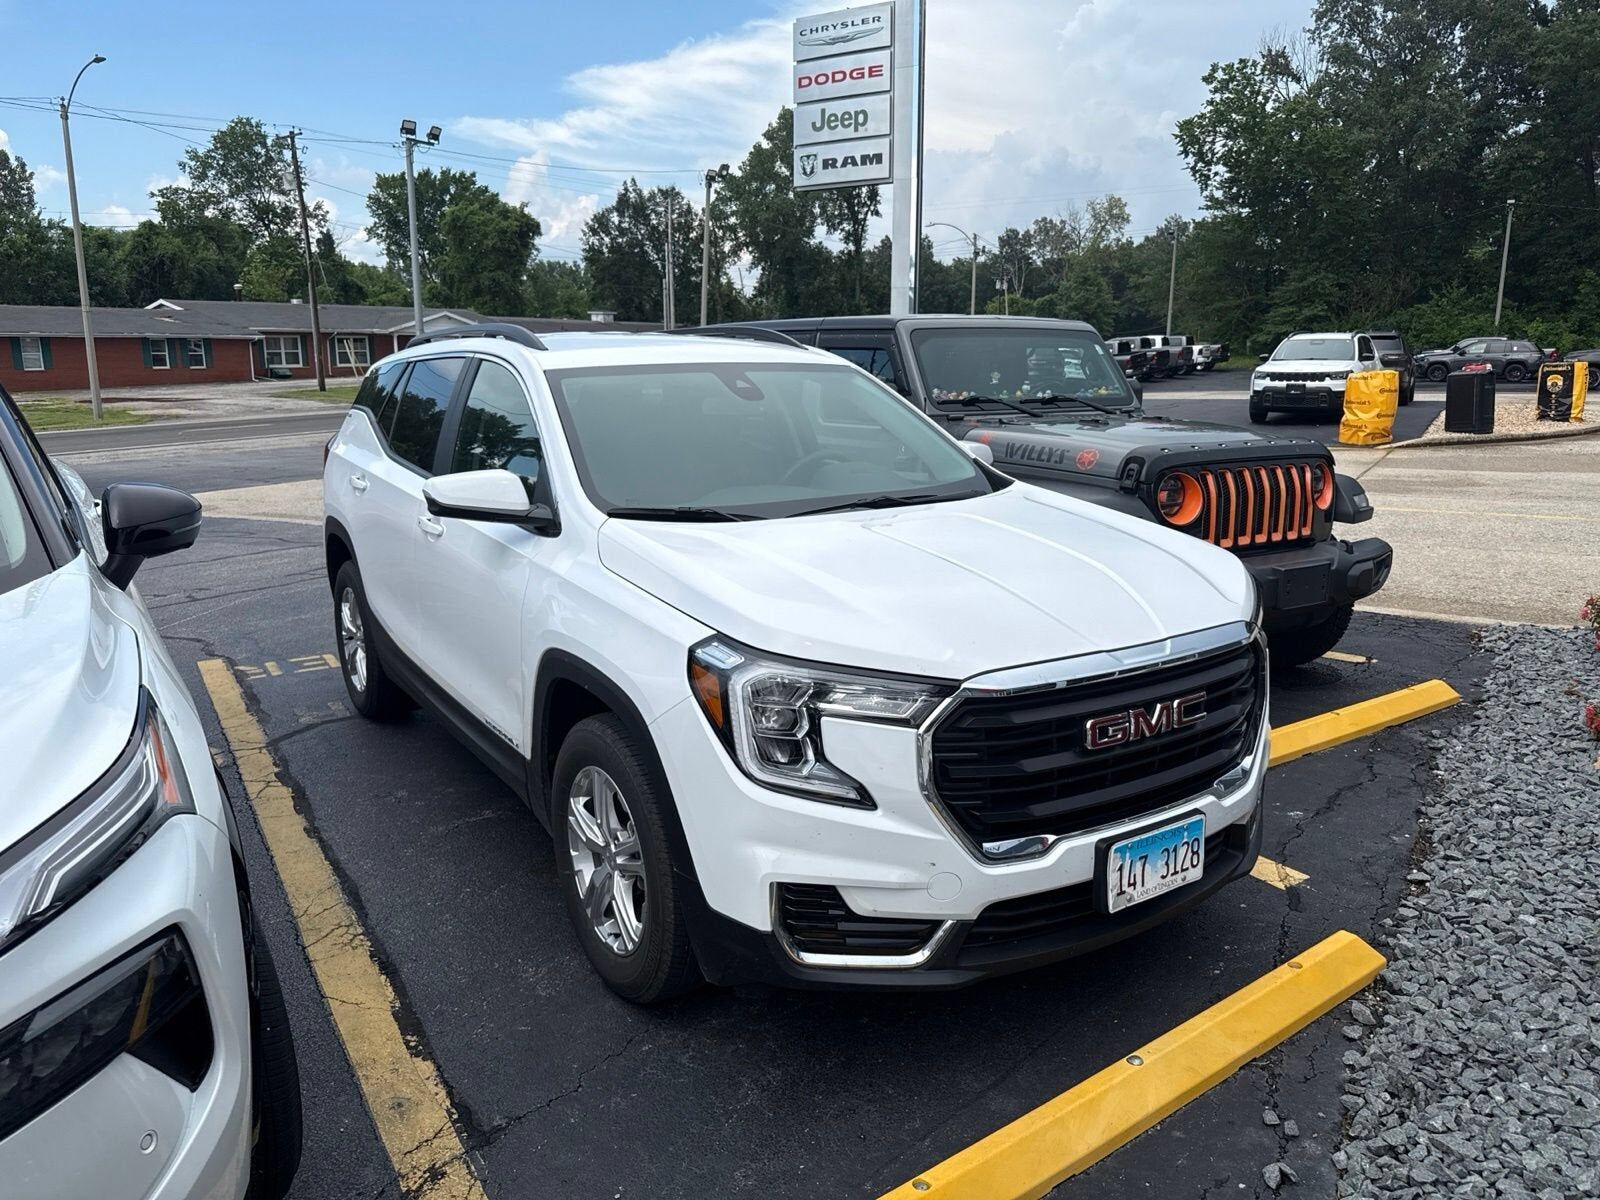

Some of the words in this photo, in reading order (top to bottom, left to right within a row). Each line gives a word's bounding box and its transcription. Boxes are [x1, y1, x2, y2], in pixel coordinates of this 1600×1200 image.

[799, 15, 882, 37] CHRYSLER
[798, 64, 884, 89] DODGE
[811, 108, 869, 132] Jeep
[822, 152, 883, 171] RAM
[1004, 442, 1070, 465] WILLYS
[1084, 690, 1207, 750] GMC
[1116, 853, 1149, 897] 147
[1160, 837, 1200, 880] 3128
[1136, 887, 1151, 899] LAND
